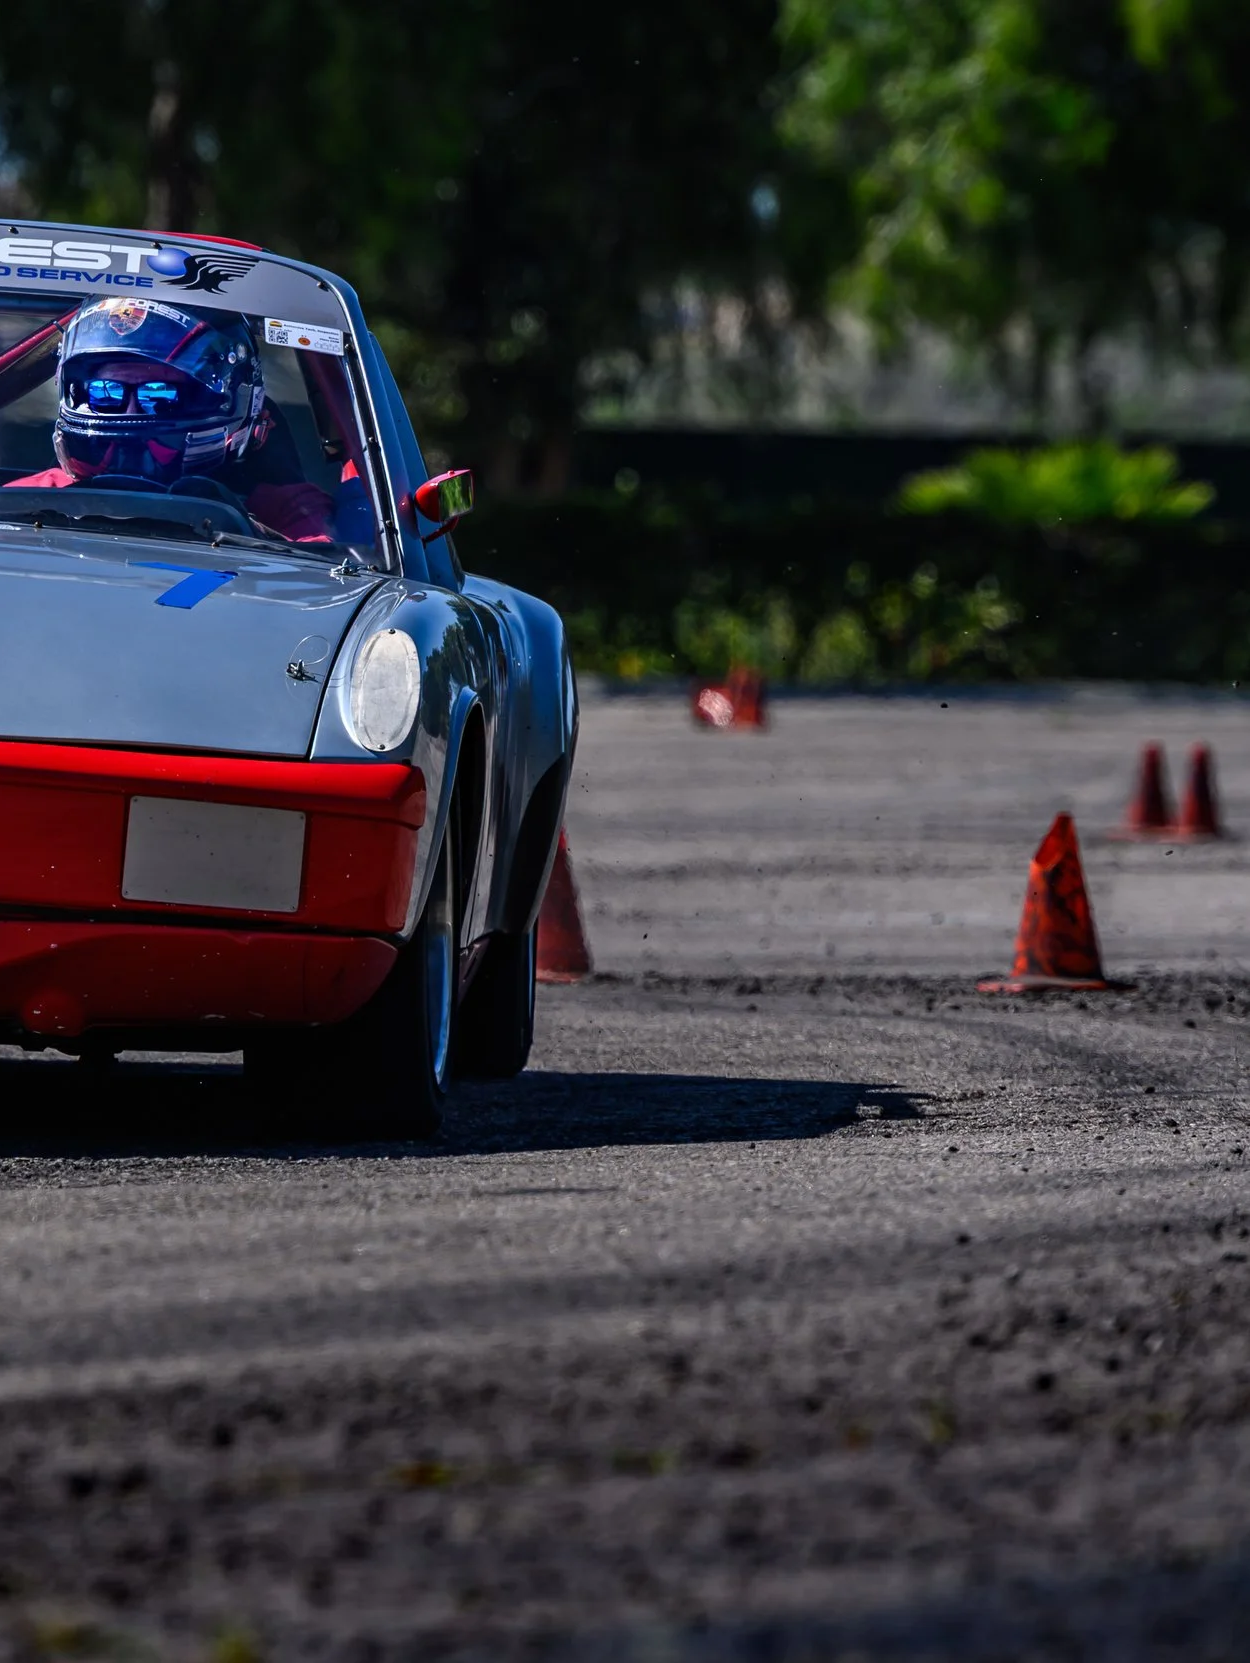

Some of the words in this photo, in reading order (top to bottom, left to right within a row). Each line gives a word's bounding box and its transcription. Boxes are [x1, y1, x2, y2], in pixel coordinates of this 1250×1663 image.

[16, 269, 154, 288] SERVICE
[125, 298, 191, 323] FOREST
[126, 561, 239, 610] 7
